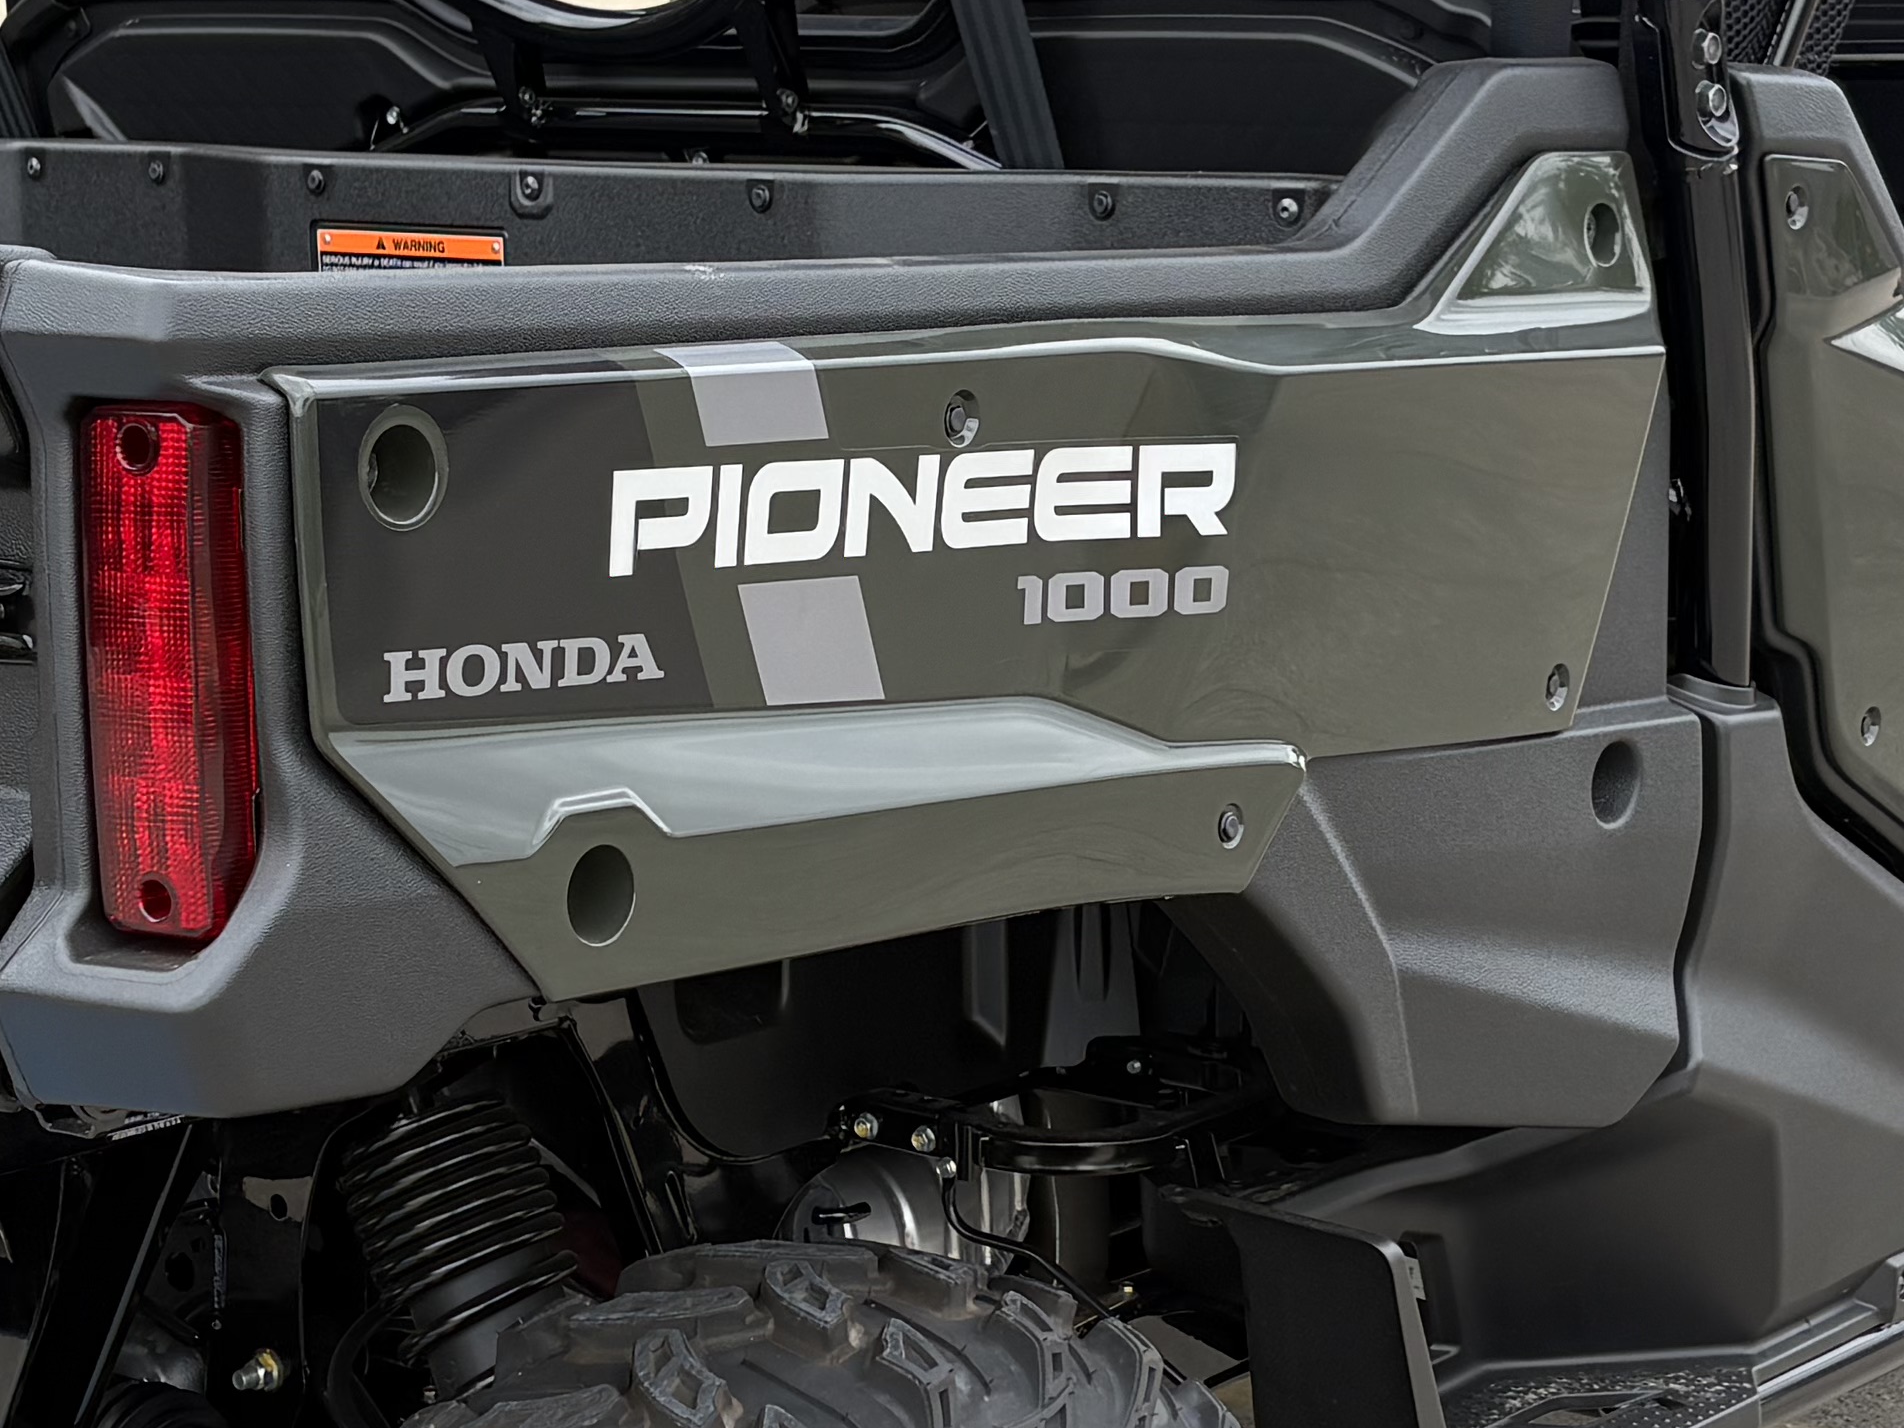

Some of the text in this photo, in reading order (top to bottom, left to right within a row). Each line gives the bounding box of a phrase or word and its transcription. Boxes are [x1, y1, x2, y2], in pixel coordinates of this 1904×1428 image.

[391, 237, 446, 254] WARNING
[608, 441, 1237, 578] PIONEER
[1017, 565, 1229, 626] 1000
[382, 633, 665, 704] HONDA
